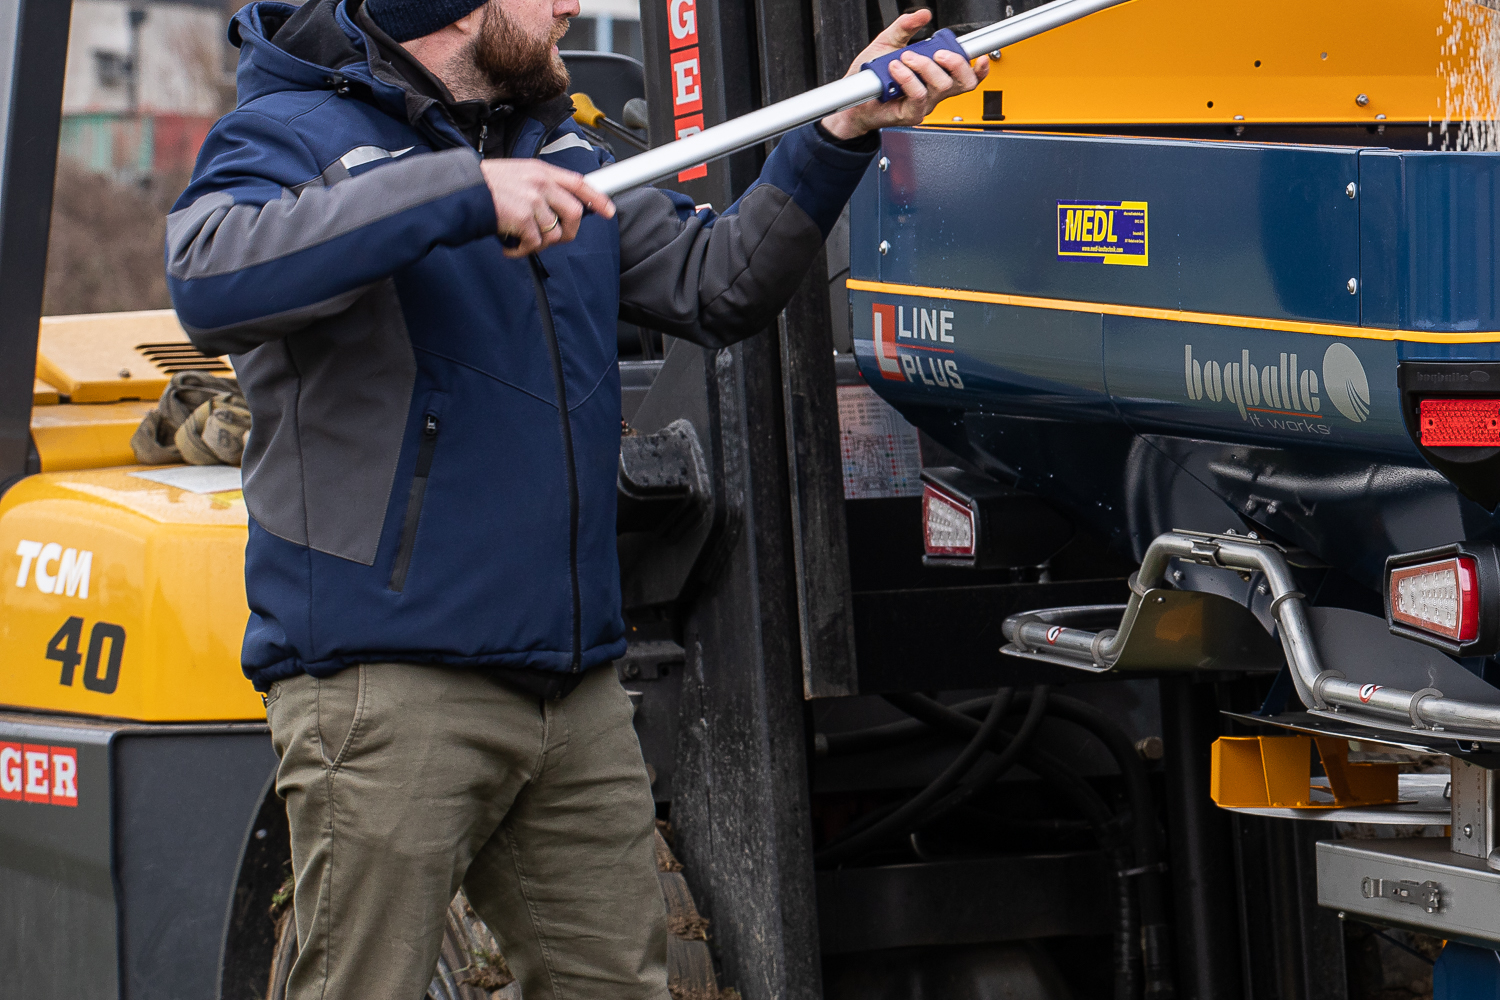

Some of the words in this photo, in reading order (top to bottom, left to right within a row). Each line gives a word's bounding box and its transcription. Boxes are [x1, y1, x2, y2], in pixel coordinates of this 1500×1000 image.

[1064, 209, 1118, 243] MEDL
[898, 305, 955, 343] LINE
[900, 353, 964, 390] PLUS
[1184, 344, 1321, 422] bogballe
[1248, 412, 1264, 429] it
[1266, 419, 1332, 436] works
[15, 539, 94, 600] TCM
[45, 615, 127, 695] 40
